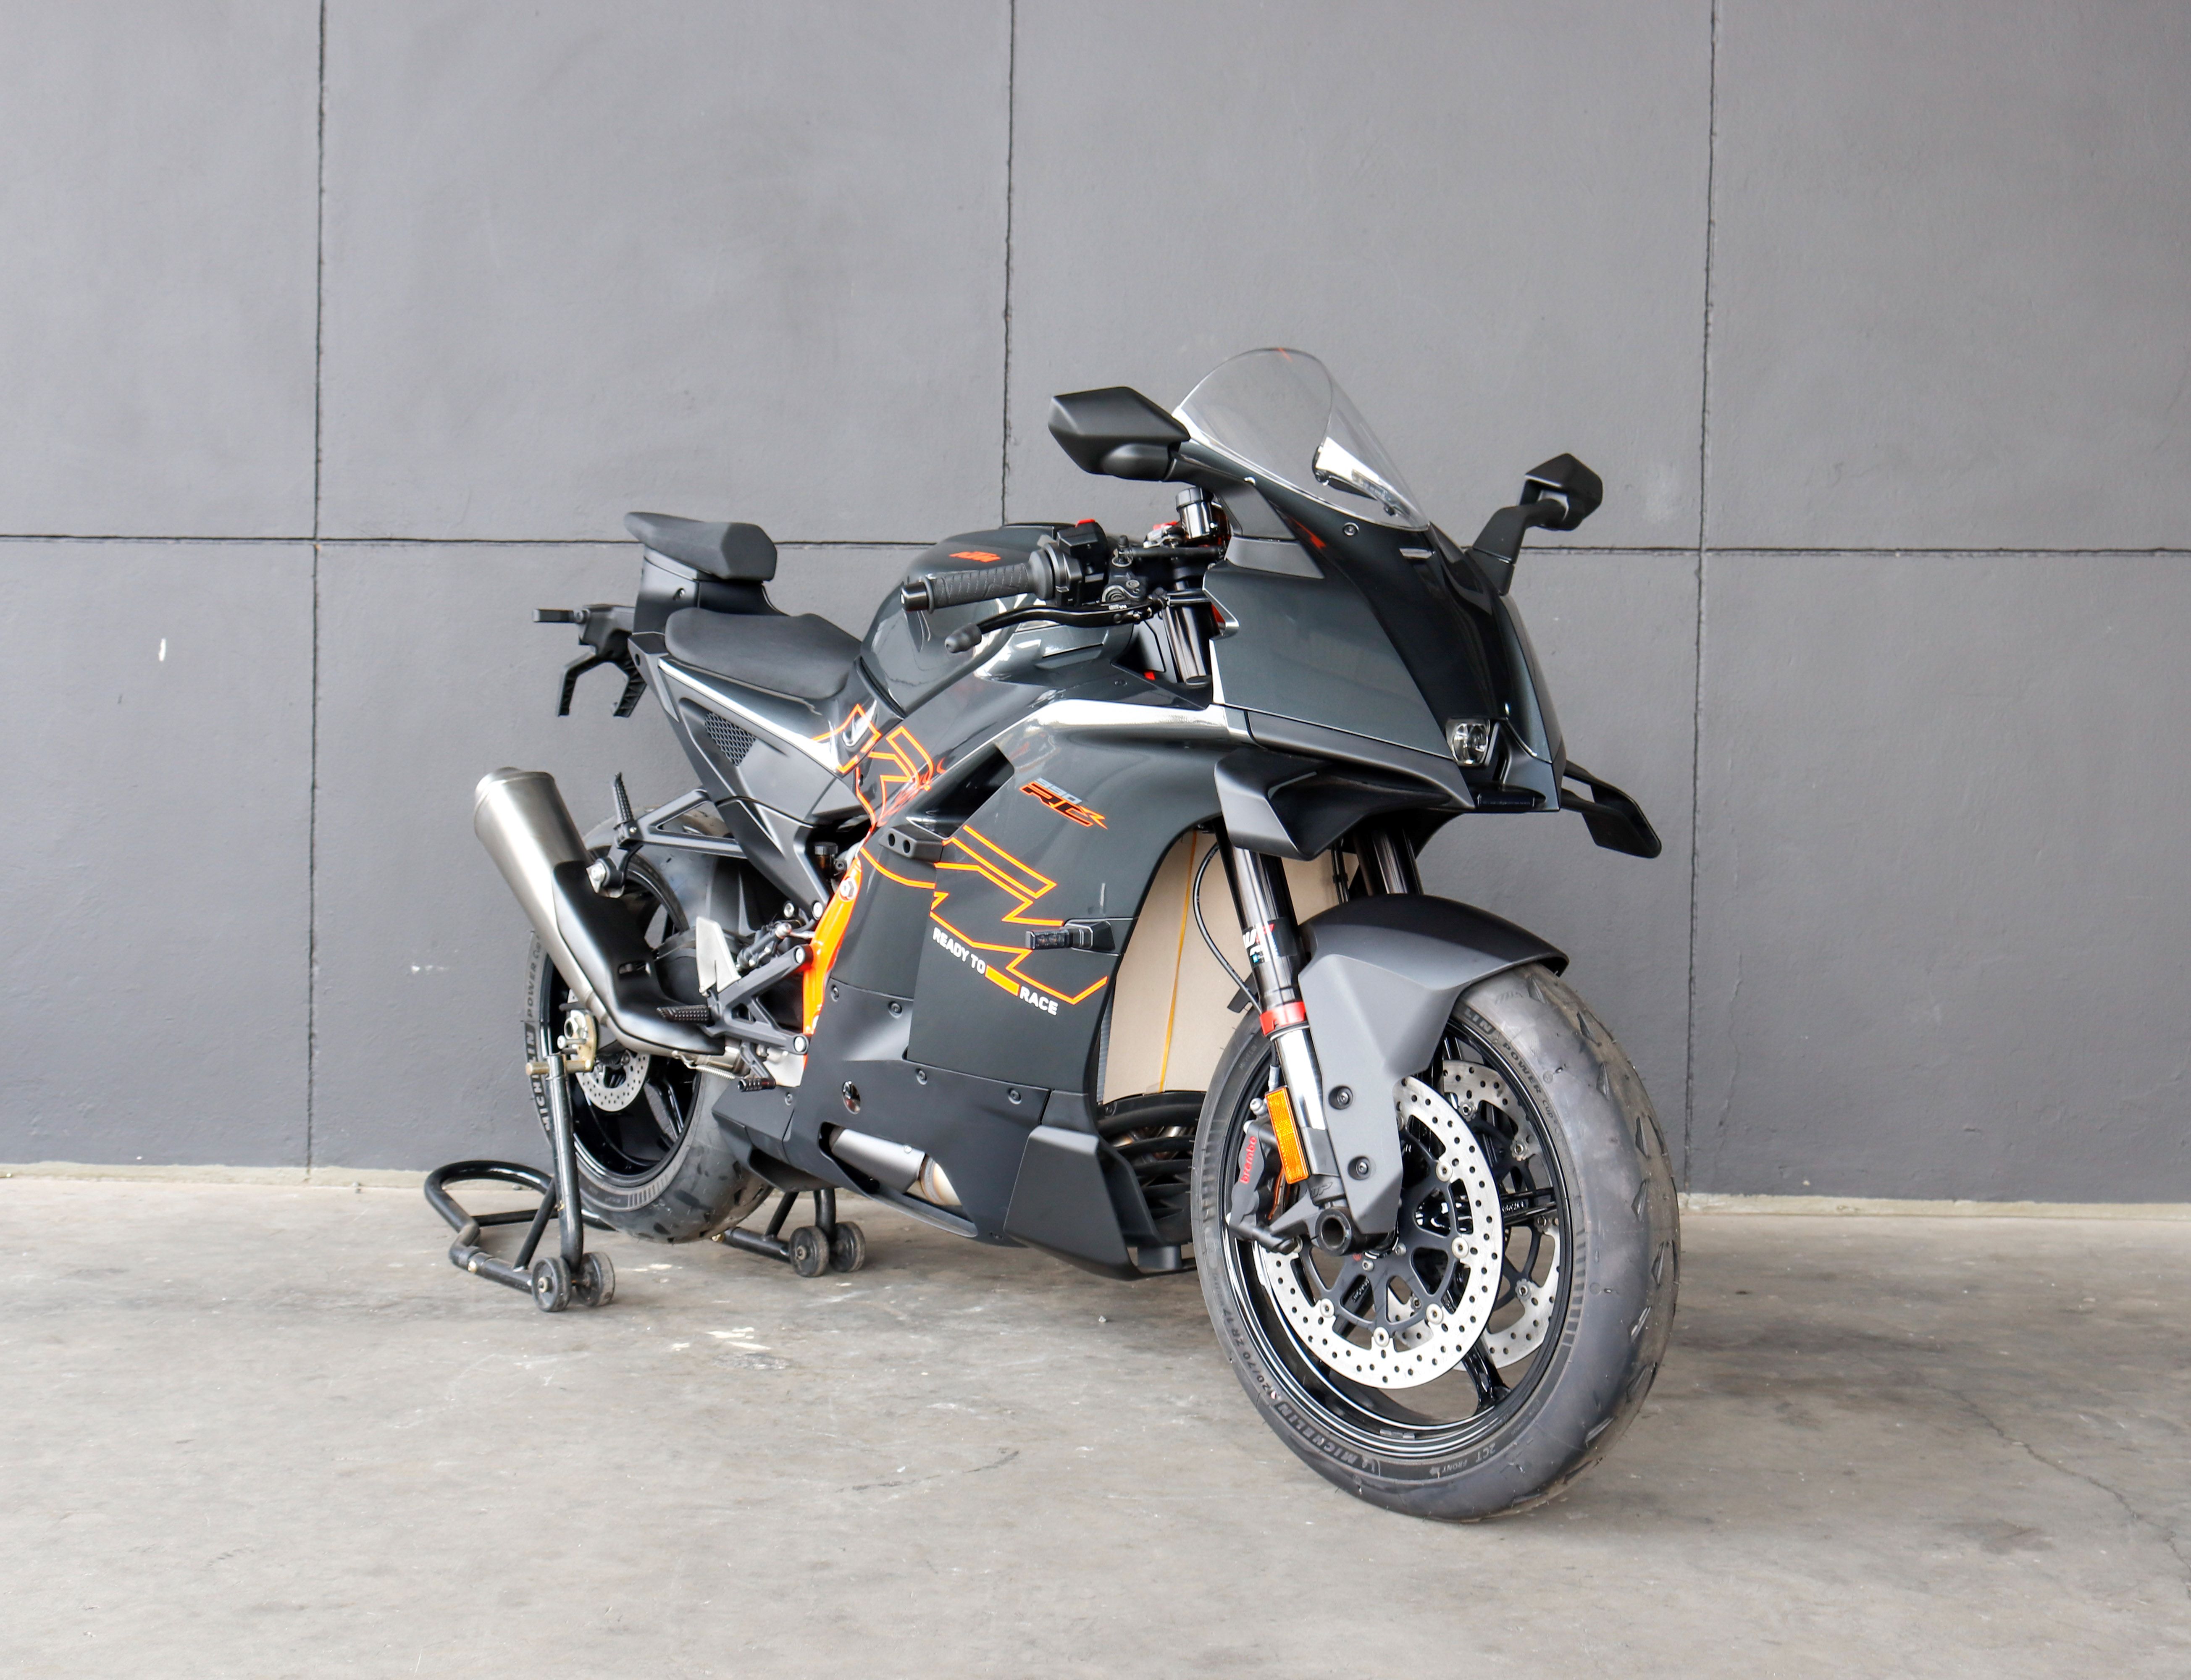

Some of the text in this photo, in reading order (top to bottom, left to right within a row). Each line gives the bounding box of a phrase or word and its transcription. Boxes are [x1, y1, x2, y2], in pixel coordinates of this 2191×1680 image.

[1034, 777, 1082, 805] 990
[527, 962, 536, 1018] POWER
[933, 927, 1059, 1016] READY TO RACE
[526, 1032, 551, 1131] MICHIN
[1503, 1042, 1542, 1093] POWER
[1240, 1136, 1257, 1184] brembo
[1277, 1402, 1358, 1465] MICHELIN
[1442, 1459, 1468, 1473] FRONT
